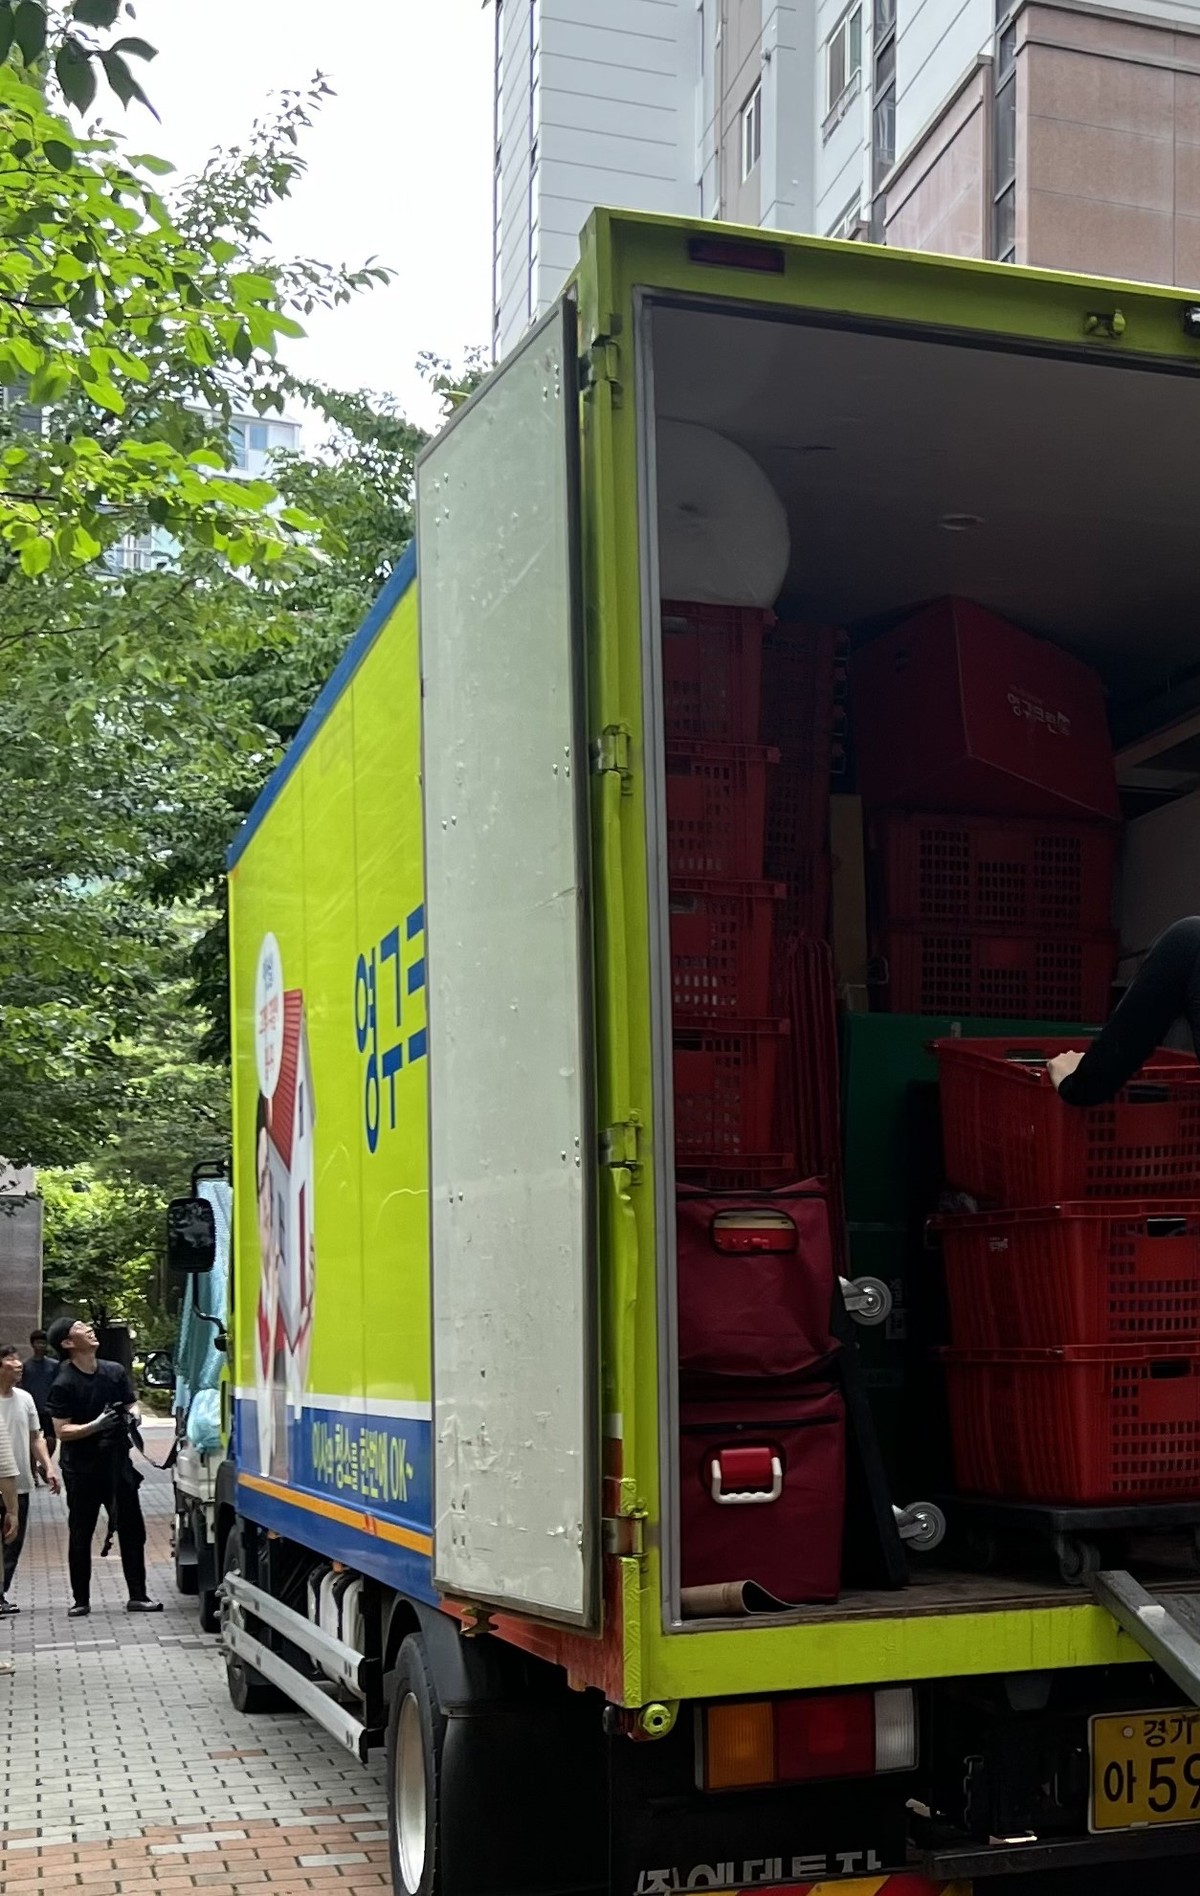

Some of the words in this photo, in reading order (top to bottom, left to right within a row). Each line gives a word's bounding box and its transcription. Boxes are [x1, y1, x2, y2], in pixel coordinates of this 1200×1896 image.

[335, 1423, 360, 1490] 청소를
[360, 1427, 388, 1502] 한번에
[1143, 1718, 1192, 1748] 경기
